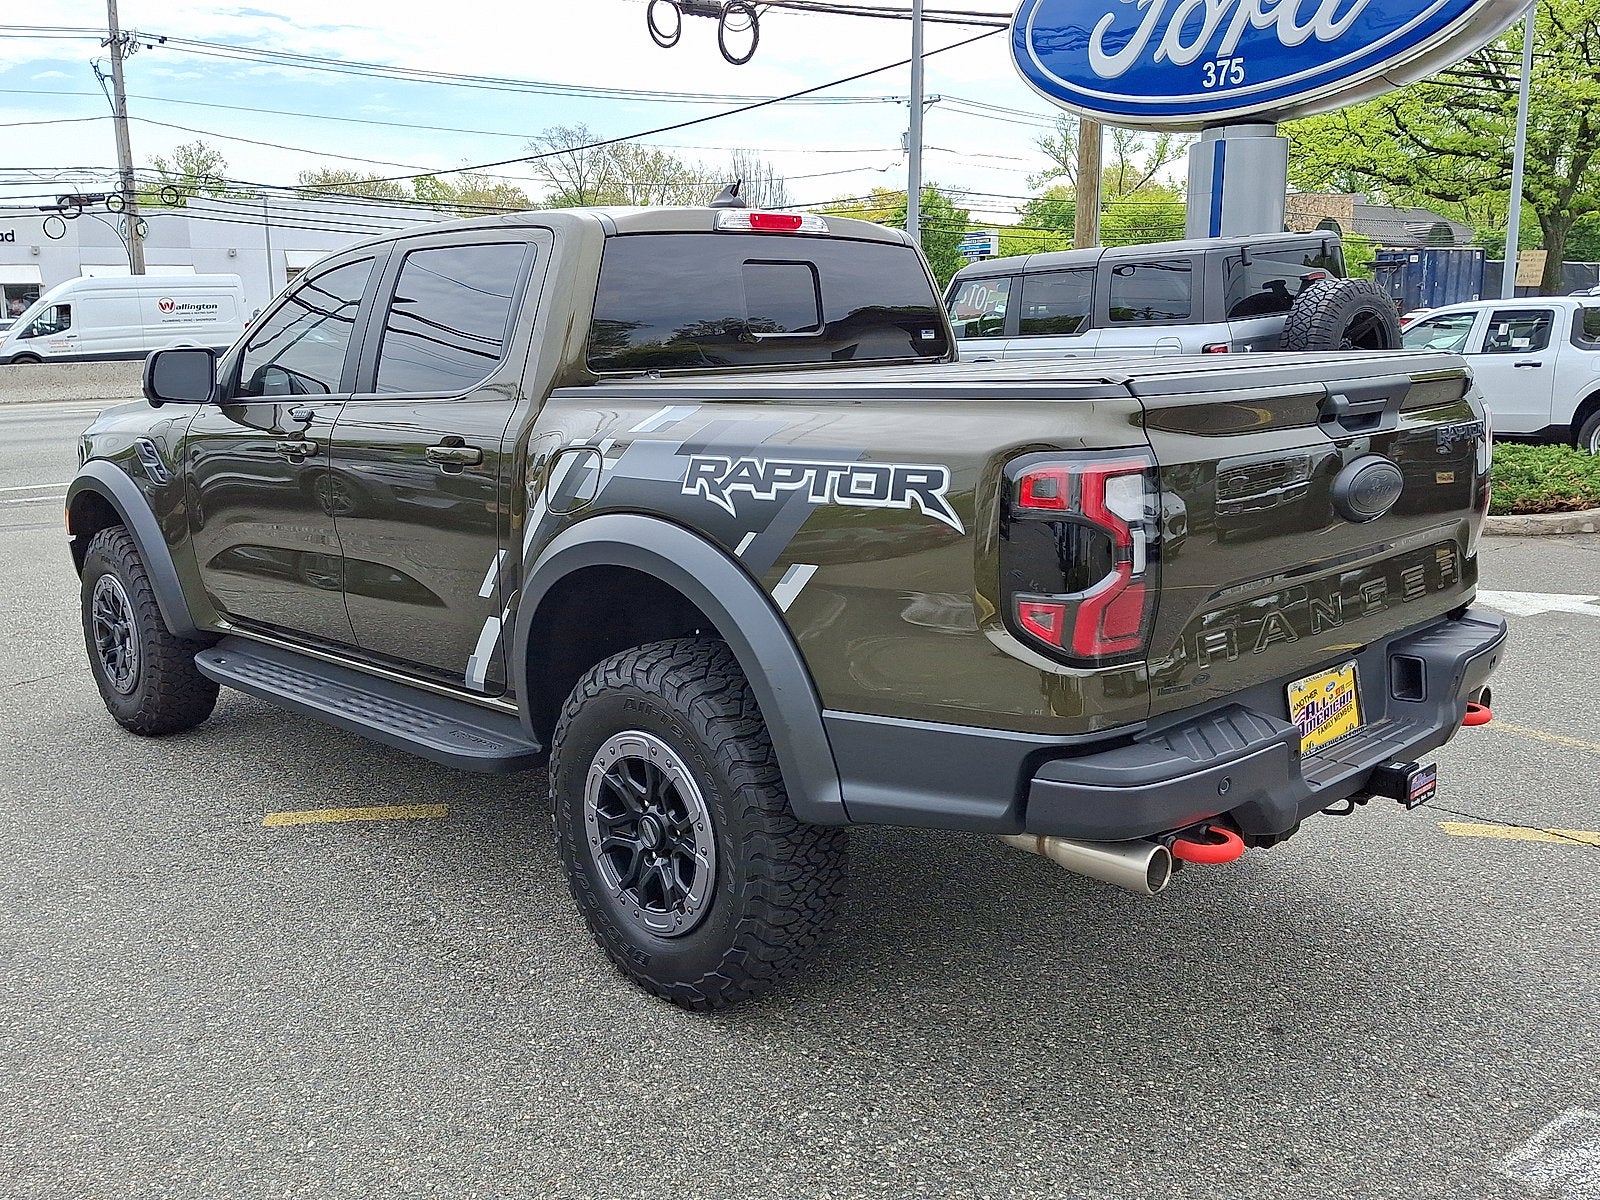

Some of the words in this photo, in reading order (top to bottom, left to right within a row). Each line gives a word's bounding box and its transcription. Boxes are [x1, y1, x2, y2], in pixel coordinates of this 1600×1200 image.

[1202, 57, 1245, 88] 375
[158, 297, 218, 313] Wallington
[1436, 420, 1485, 452] RAPTOR
[681, 454, 966, 536] RAPTOR
[1195, 548, 1459, 670] RANGER
[1292, 689, 1319, 712] ANOTHER
[1297, 689, 1353, 738] AMERICAN
[1305, 696, 1329, 721] ALL
[1317, 717, 1335, 736] FAMILY
[1334, 703, 1354, 723] MEMBER
